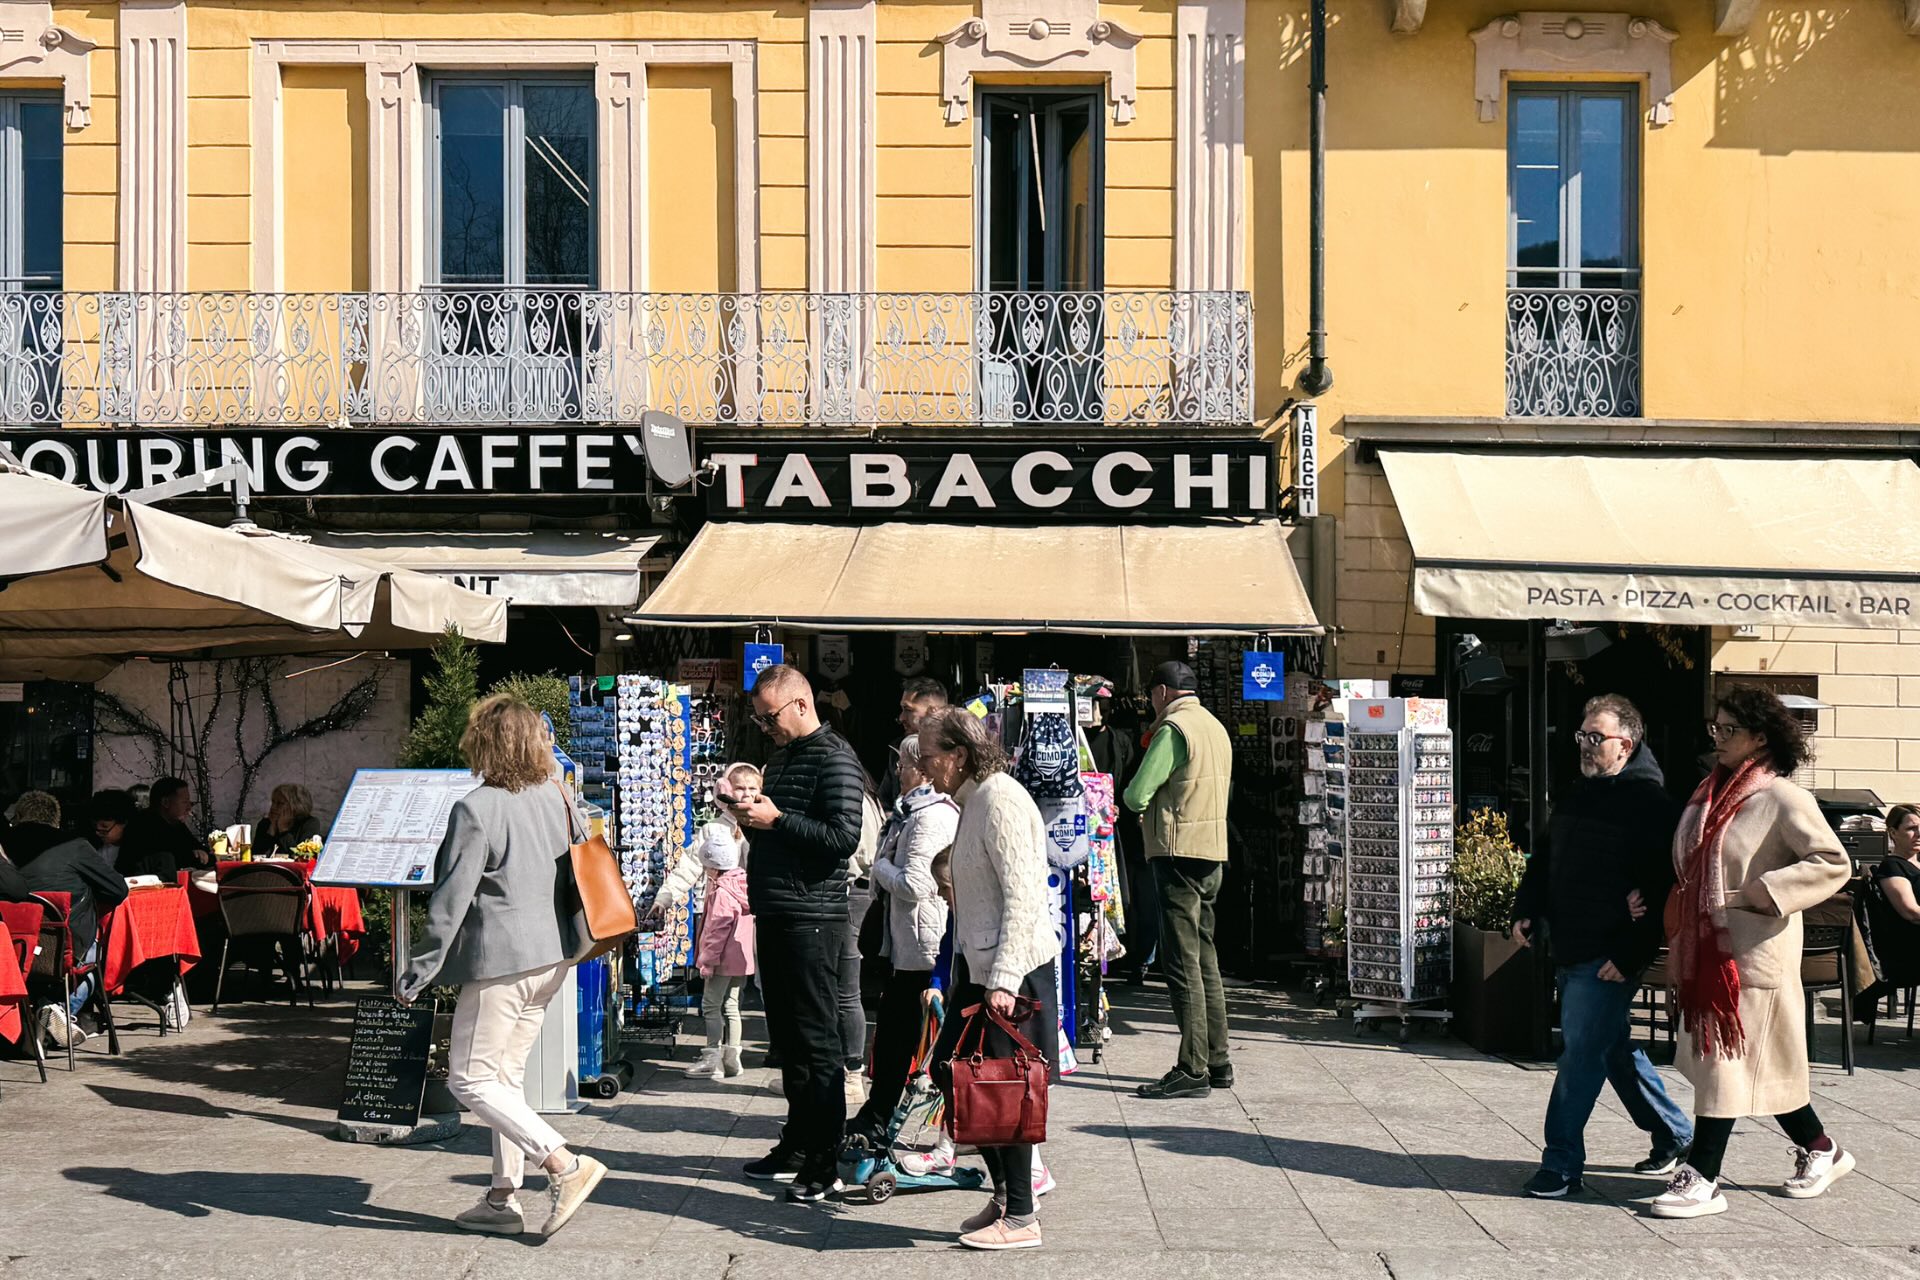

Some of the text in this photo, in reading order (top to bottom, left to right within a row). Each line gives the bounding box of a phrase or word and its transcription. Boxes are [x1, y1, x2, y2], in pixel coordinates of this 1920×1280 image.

[1301, 408, 1314, 514] TABACCHI
[710, 450, 1267, 510] TABACCHI
[1527, 587, 1911, 616] PASTA PIZZA COCKTAIL BAR
[1036, 751, 1060, 761] COMO
[1055, 829, 1074, 838] COMO
